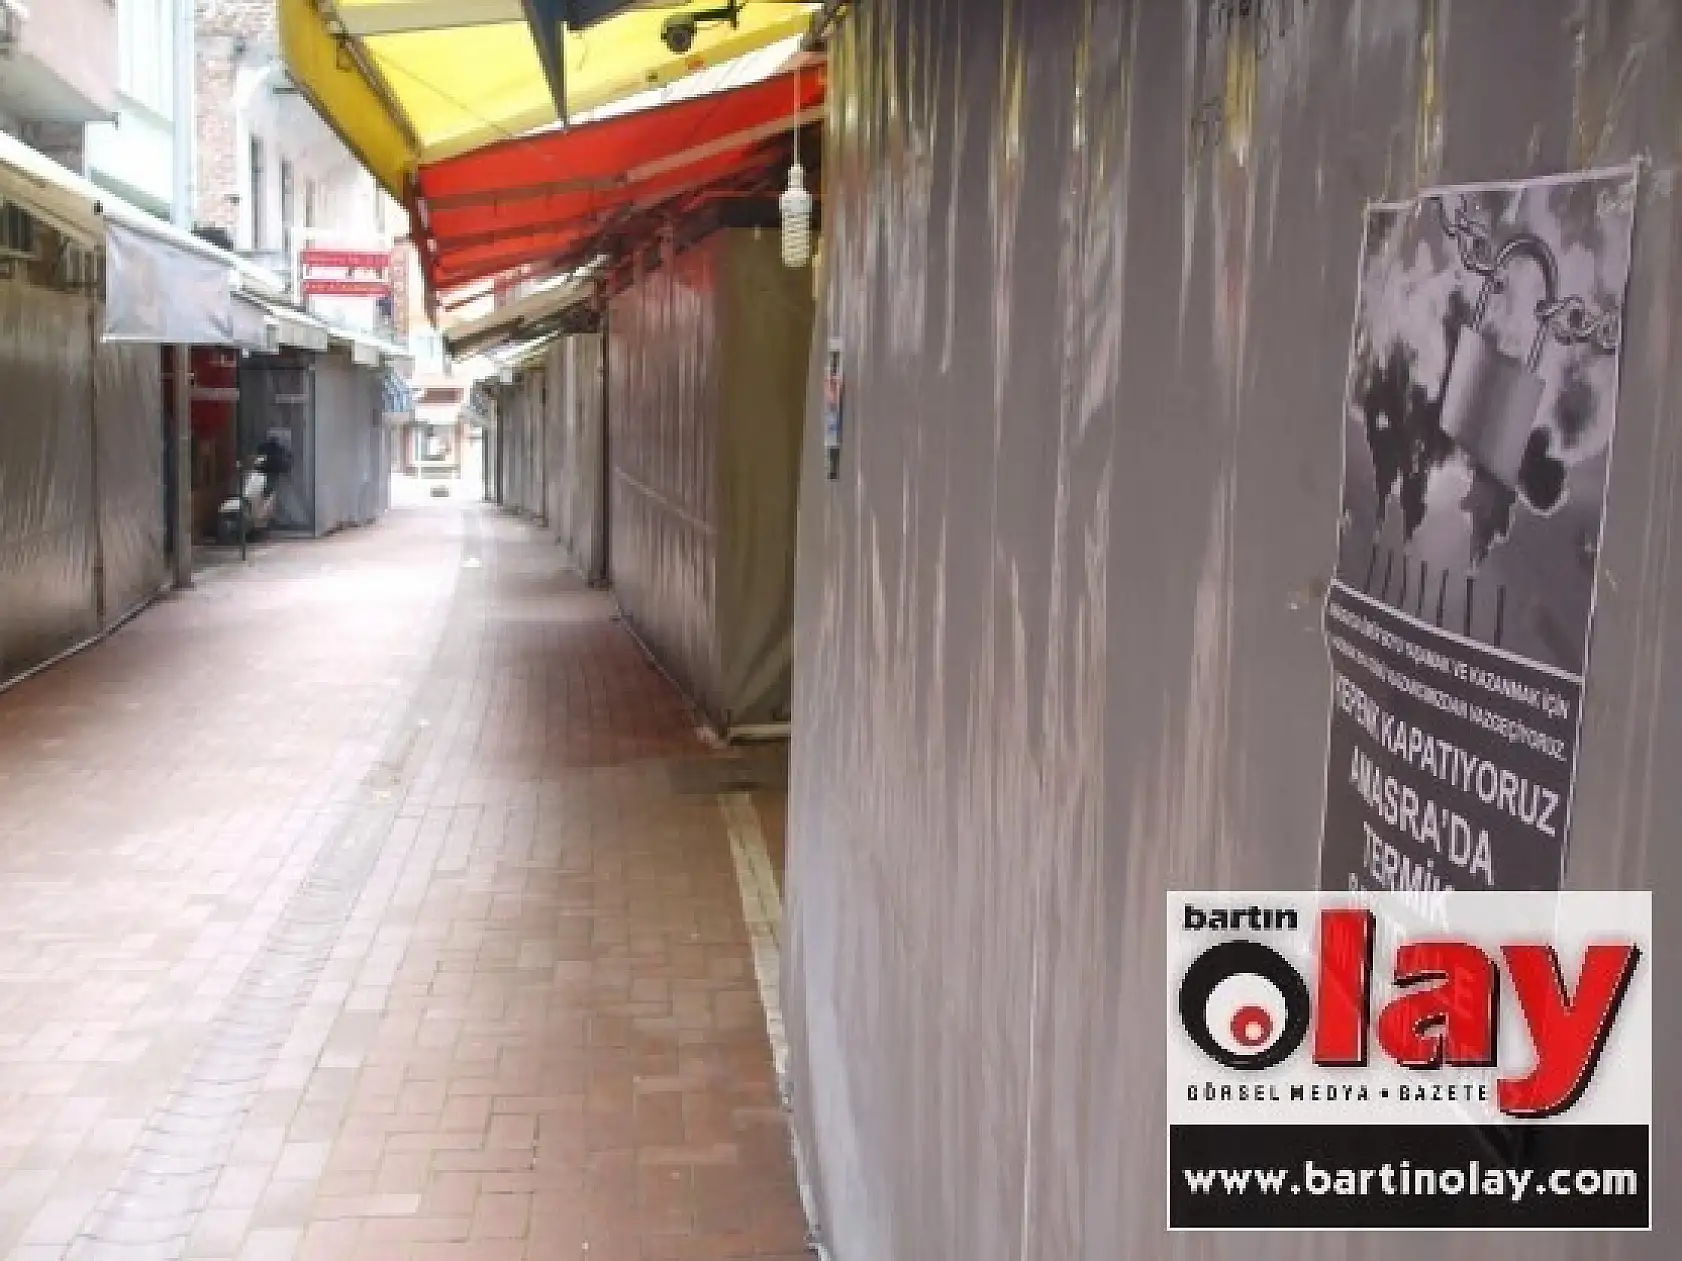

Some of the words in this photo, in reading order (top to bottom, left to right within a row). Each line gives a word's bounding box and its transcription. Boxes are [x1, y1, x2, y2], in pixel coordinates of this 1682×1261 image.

[1450, 657, 1468, 682] VE
[1468, 665, 1541, 710] KAZANMAK
[1541, 686, 1570, 719] İÇİN
[1350, 745, 1495, 887] AMASRA'DA
[1380, 709, 1561, 838] KAPATIYORUZ
